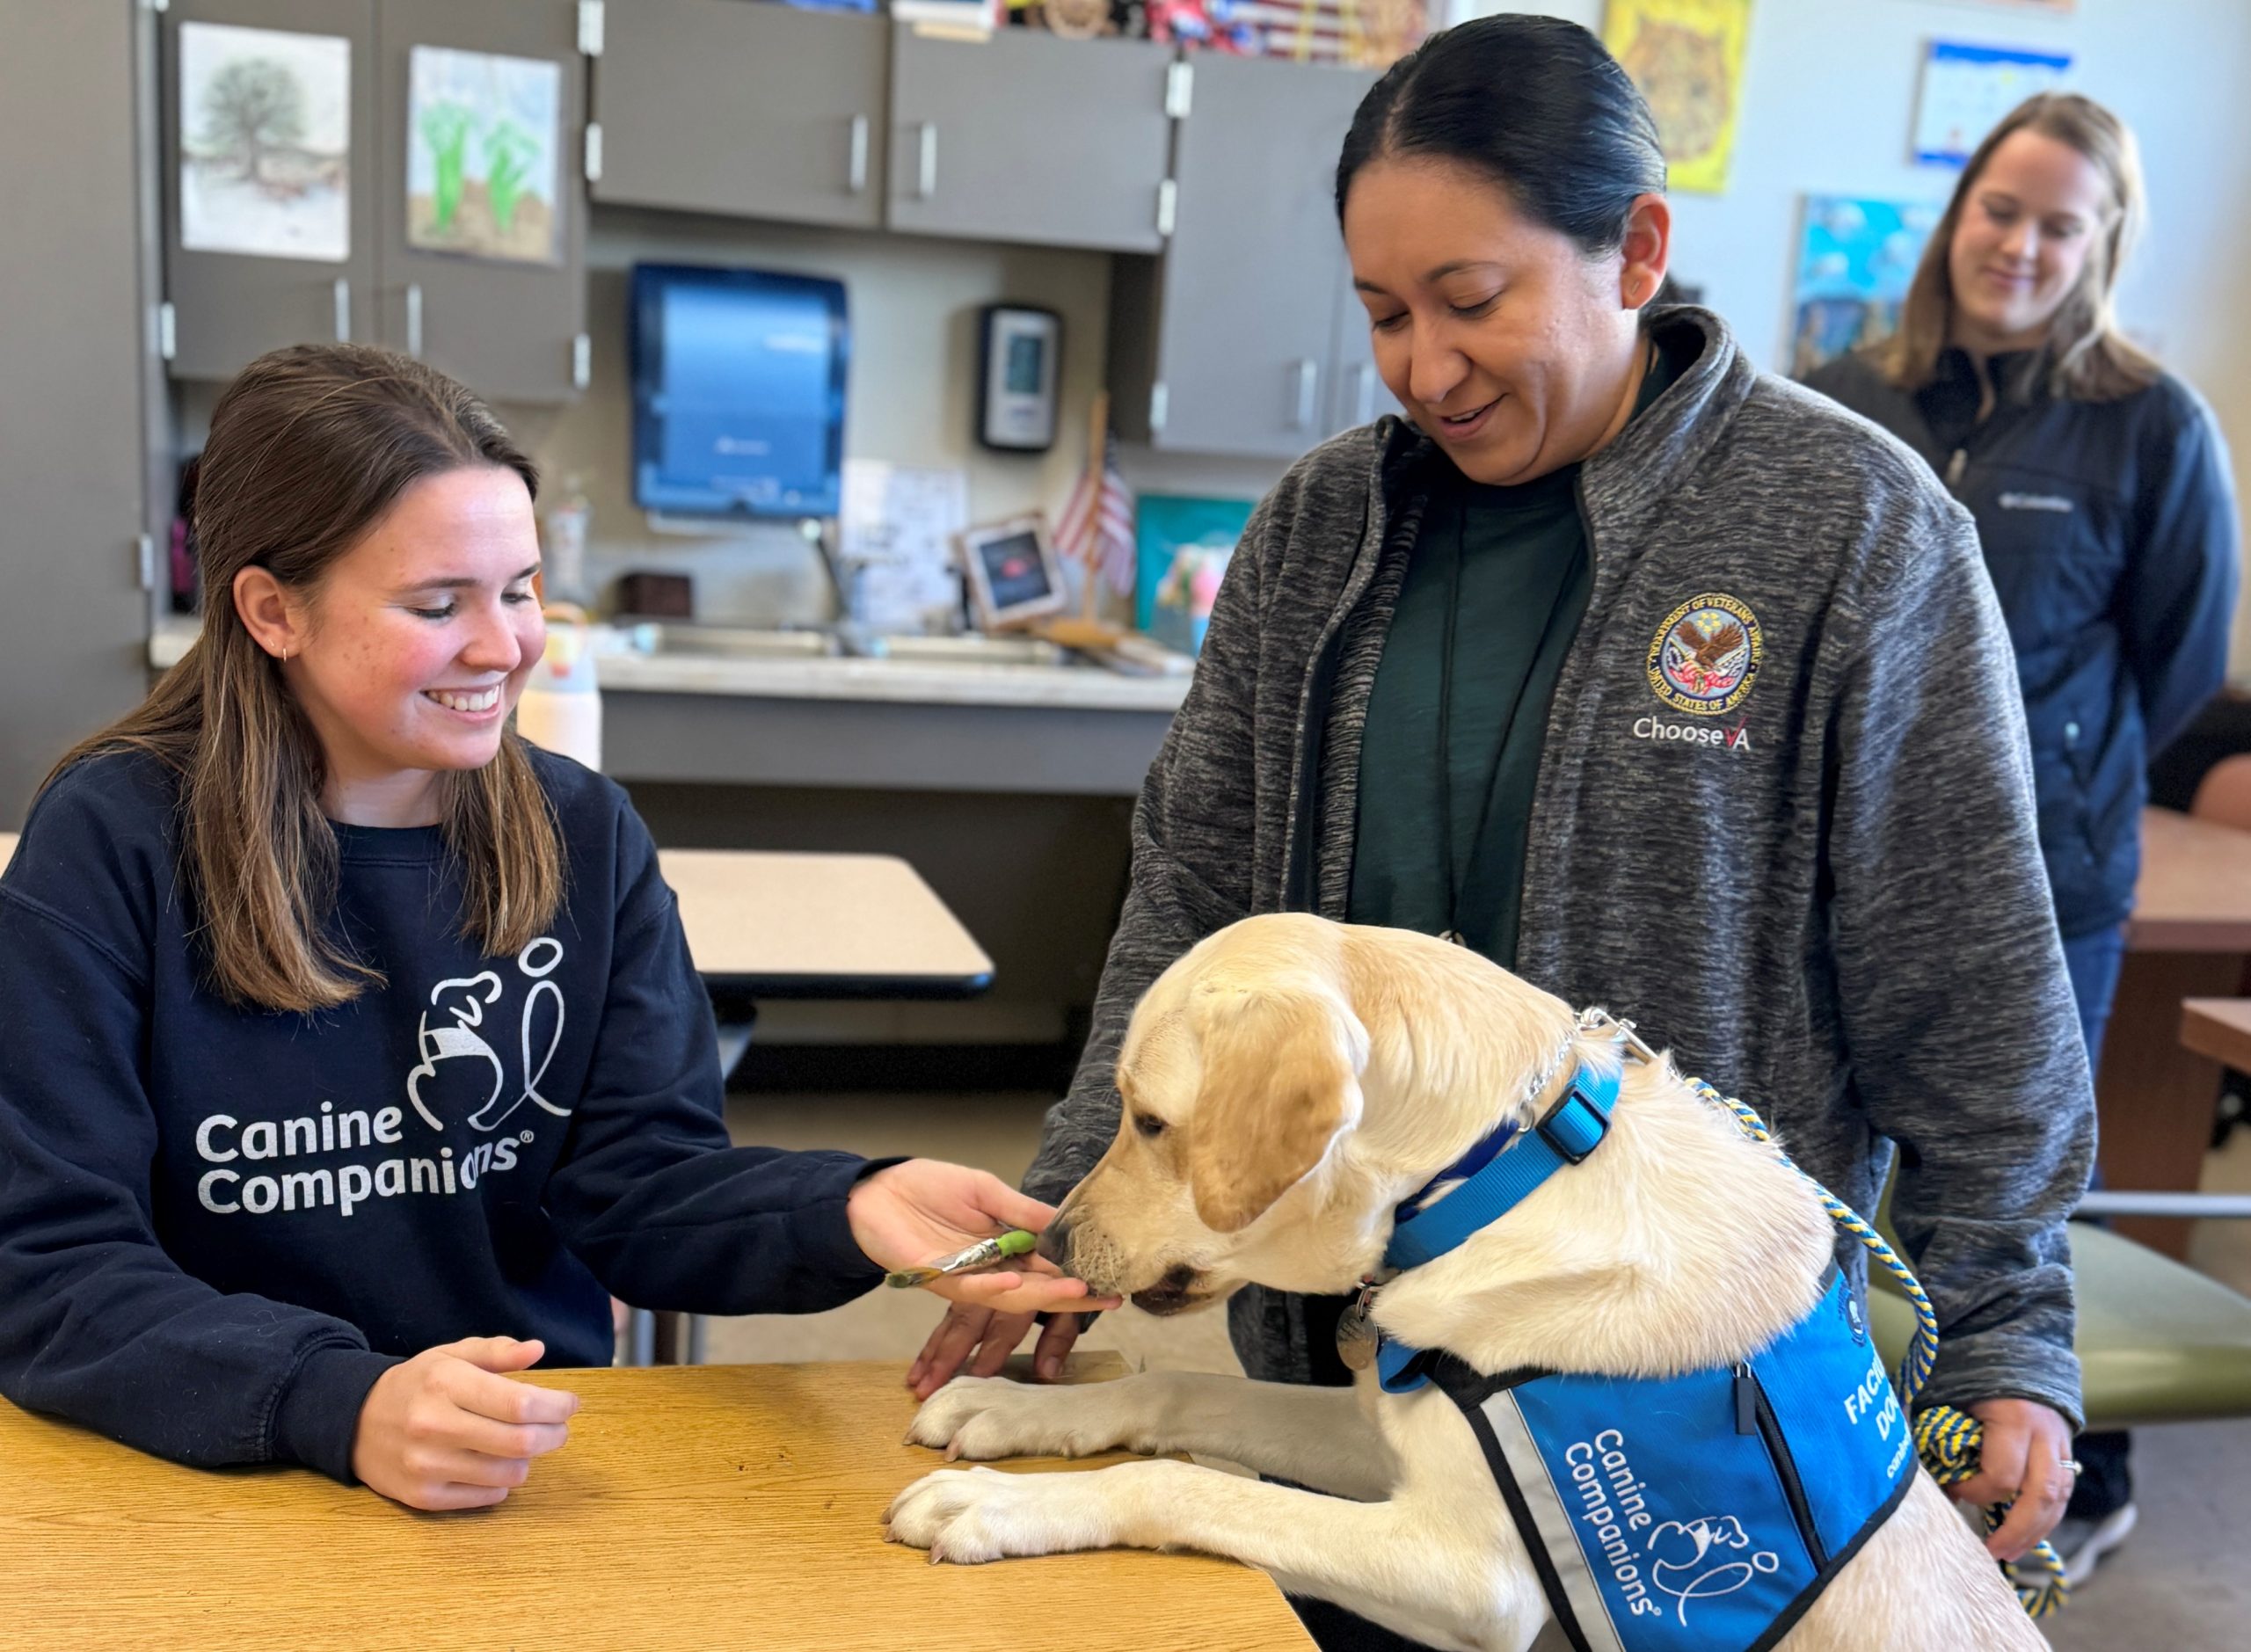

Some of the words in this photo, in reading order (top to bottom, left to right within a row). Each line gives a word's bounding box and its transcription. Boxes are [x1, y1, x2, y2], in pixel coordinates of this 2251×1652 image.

[1692, 598, 1707, 610] OF
[1707, 597, 1755, 625] VETERANS
[1673, 693, 1708, 710] STATES
[1709, 699, 1723, 710] OF
[195, 1101, 403, 1162] Canine
[1595, 1429, 1651, 1531] Canine
